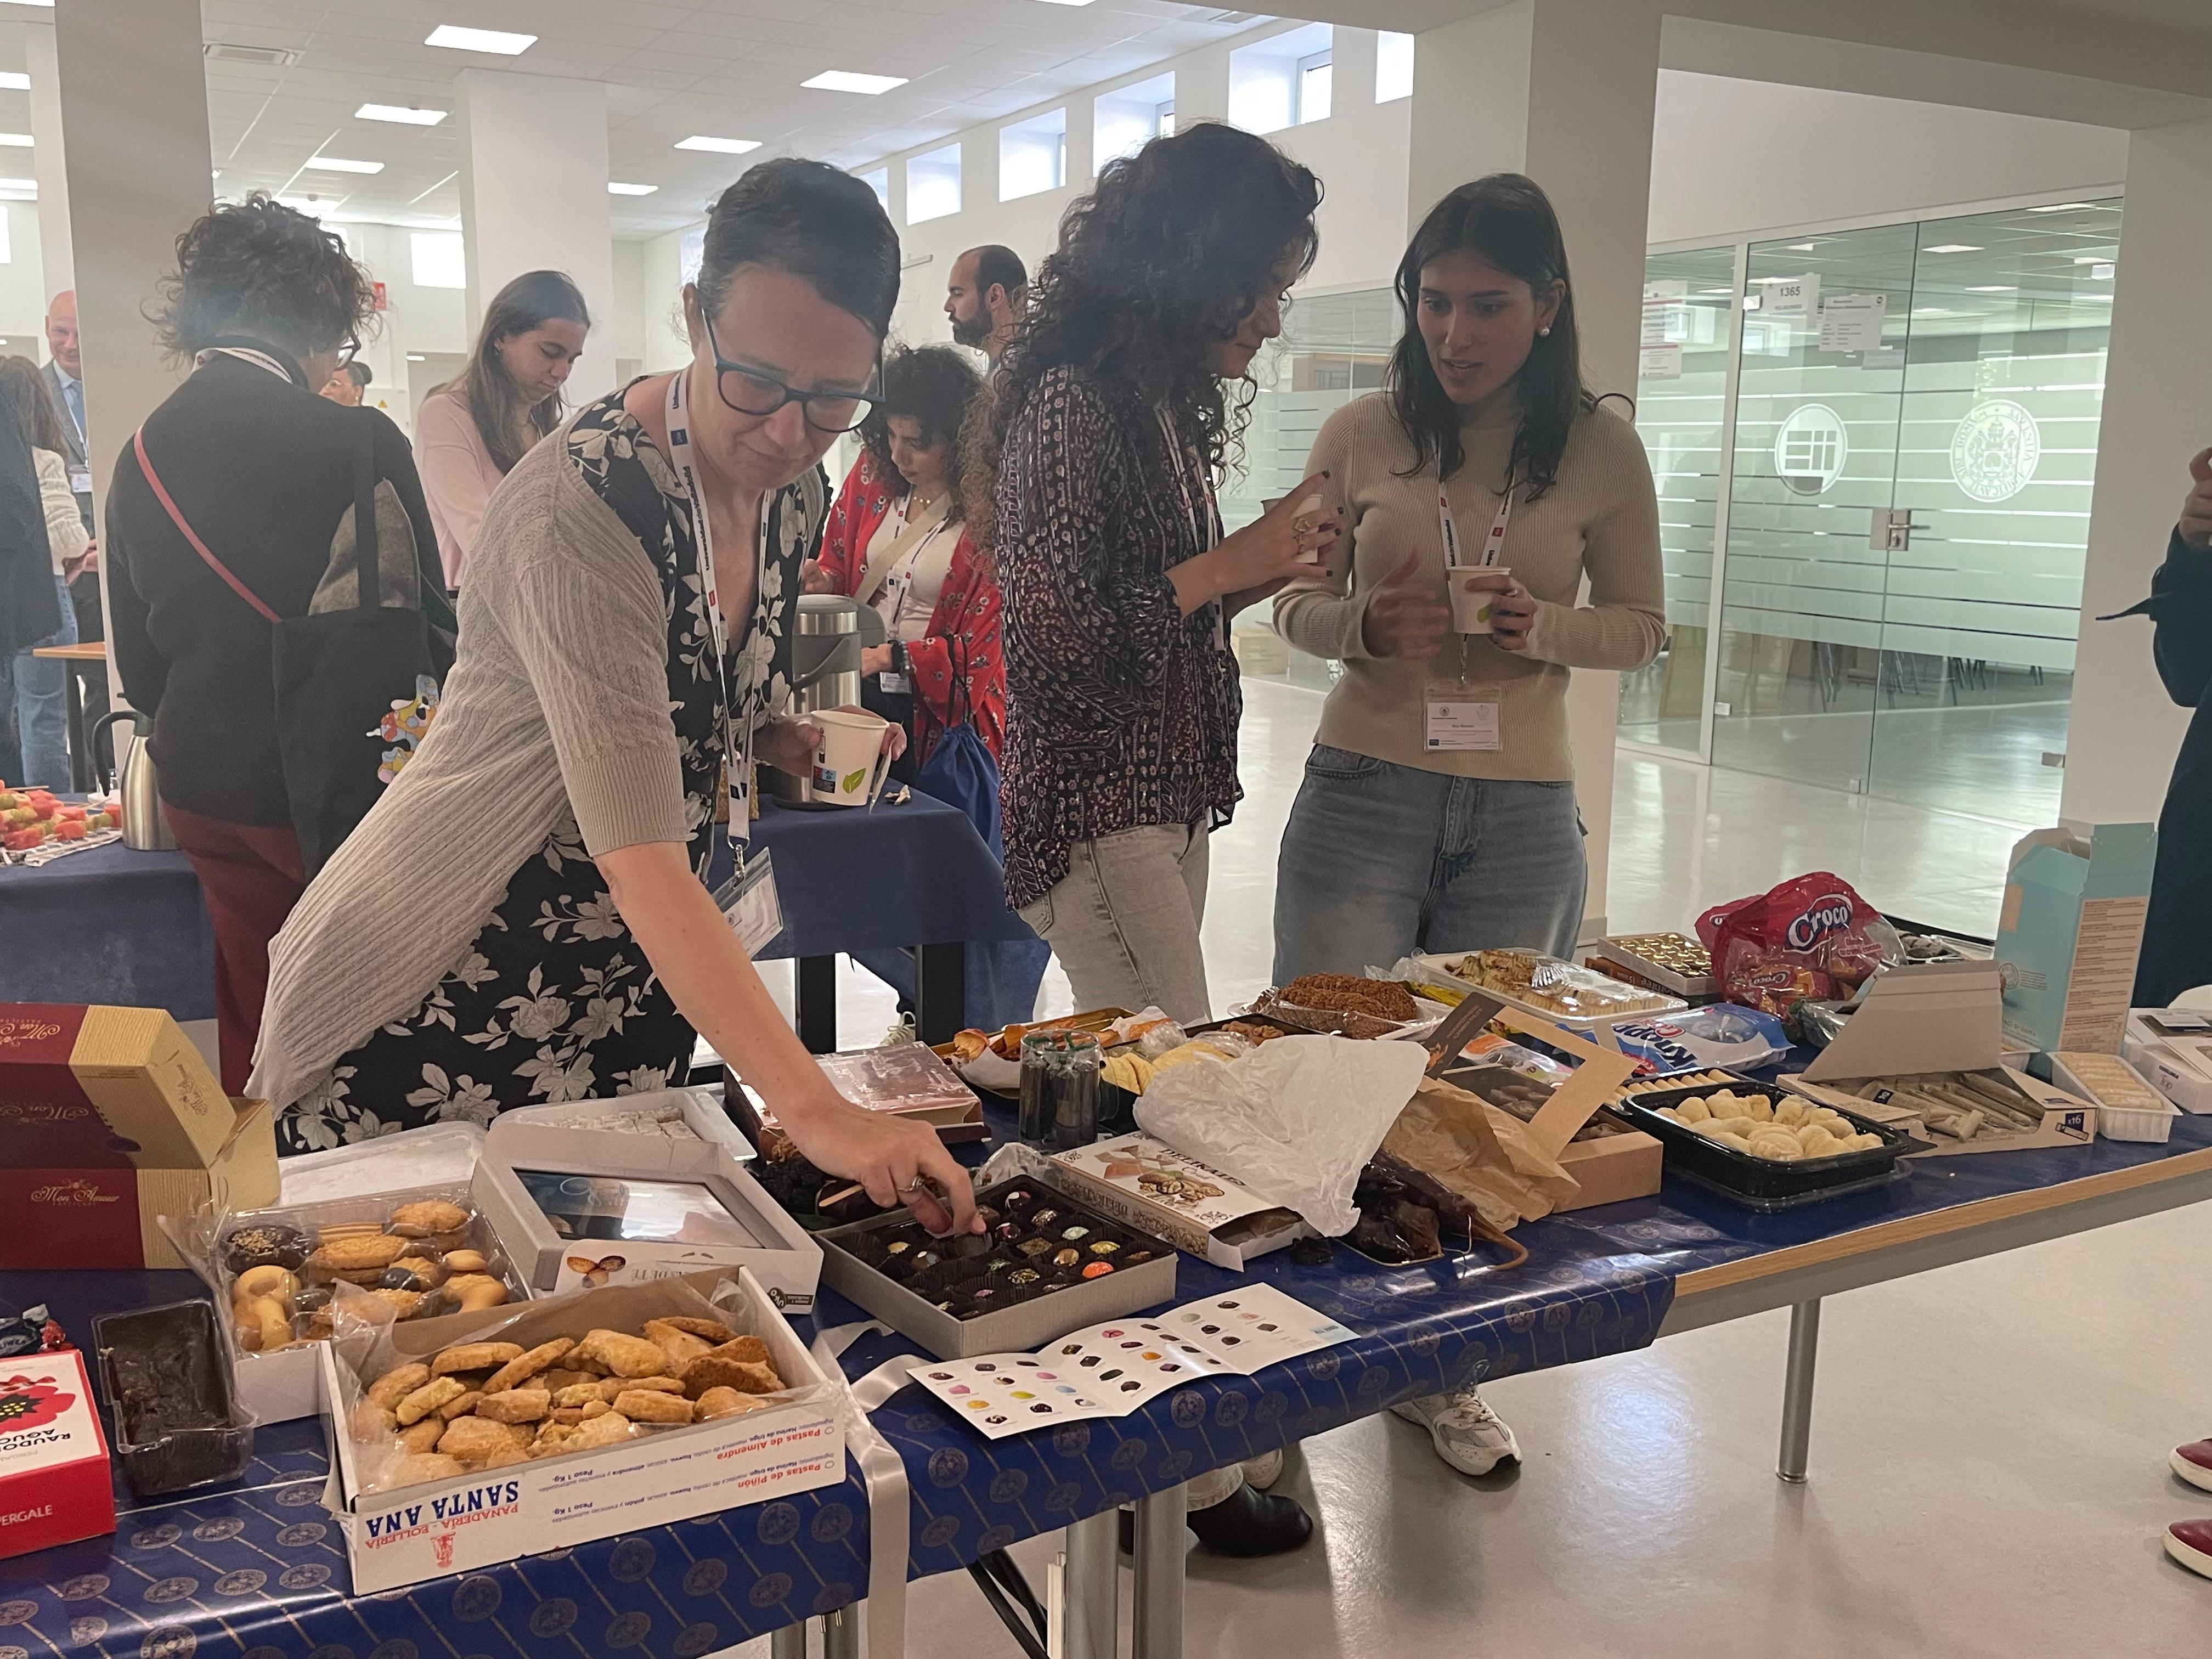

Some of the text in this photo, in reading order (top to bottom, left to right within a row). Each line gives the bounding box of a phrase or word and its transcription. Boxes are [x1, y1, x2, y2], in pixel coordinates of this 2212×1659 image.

[1780, 286, 1801, 296] 1365
[1787, 906, 1849, 948] Croco
[1753, 972, 1787, 985] Croco
[2067, 1114, 2082, 1125] x16
[0, 1432, 71, 1452] RAUDO
[787, 1429, 820, 1441] Pastas
[718, 1441, 767, 1459] Almendra
[787, 1464, 820, 1475] Pastas
[738, 1476, 767, 1487] Piñón
[0, 1504, 53, 1526] ERGALE
[366, 1481, 518, 1537] SANTA ANA
[365, 1504, 518, 1549] PANADERÍA BOLLERÍA
